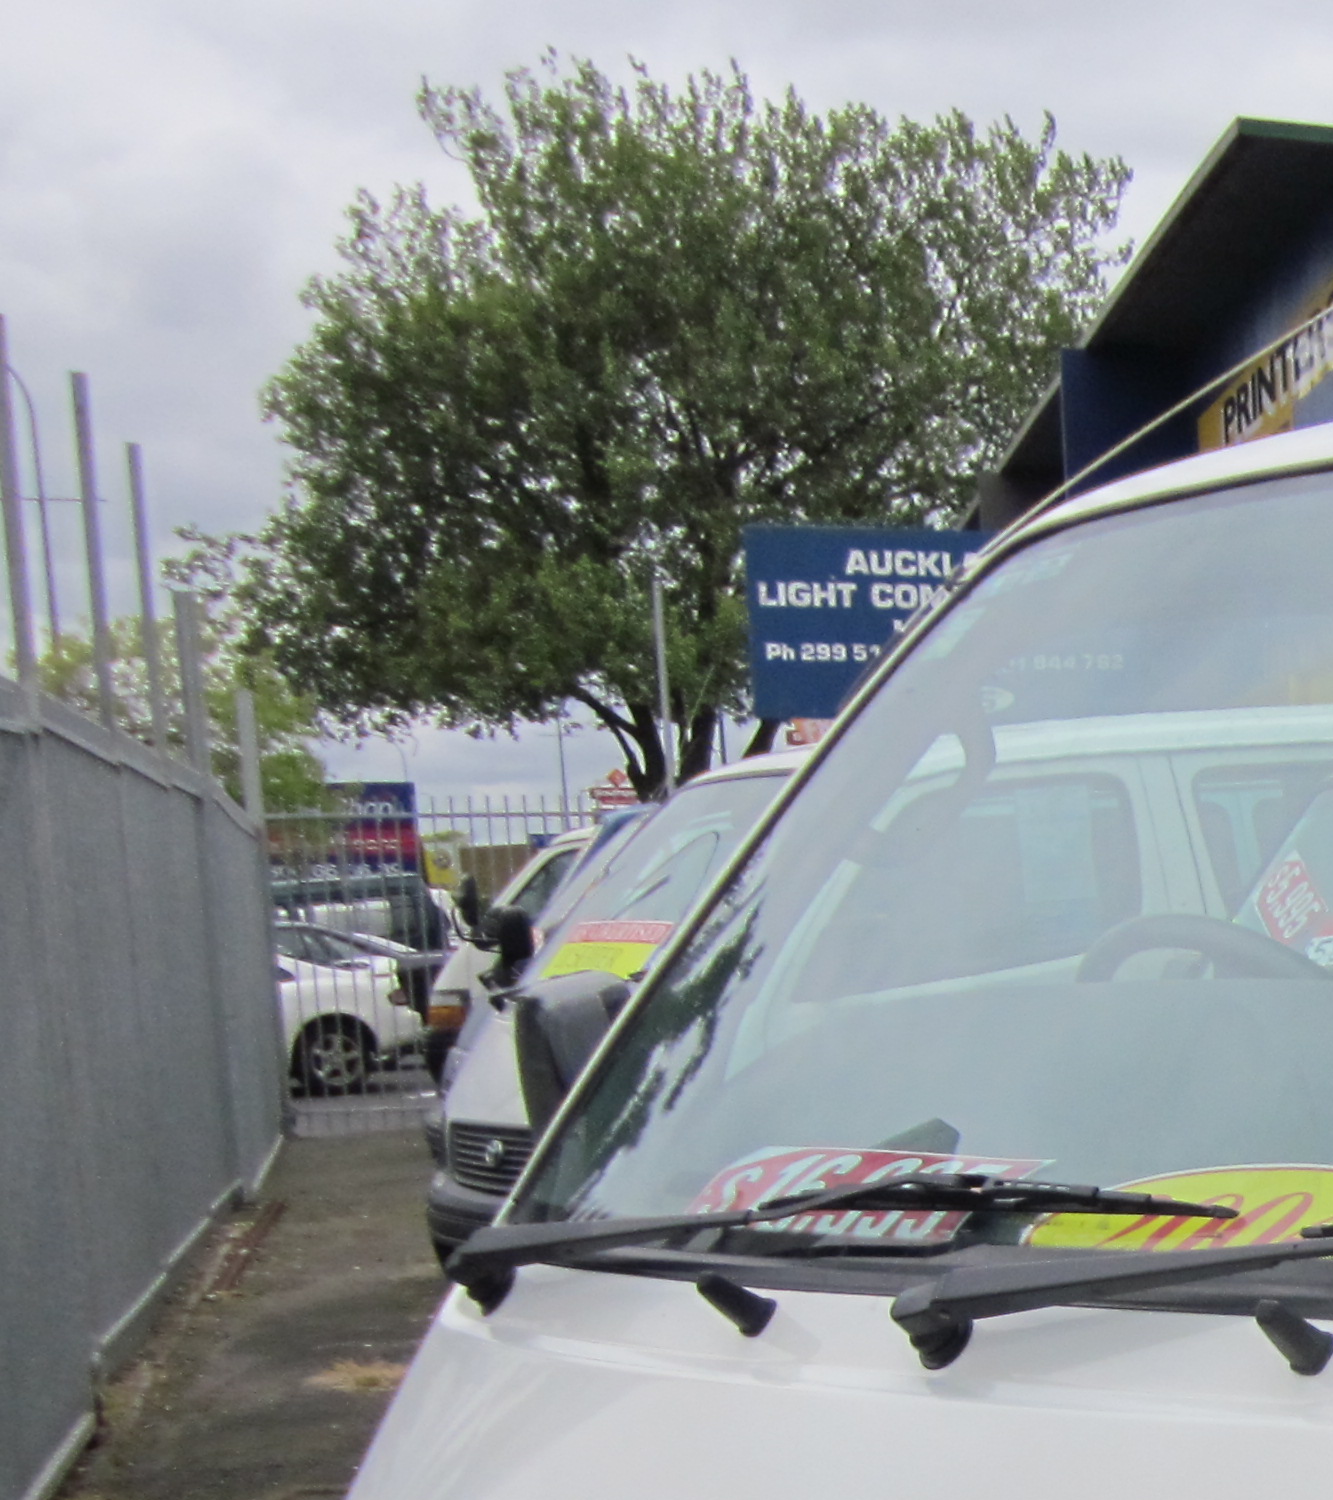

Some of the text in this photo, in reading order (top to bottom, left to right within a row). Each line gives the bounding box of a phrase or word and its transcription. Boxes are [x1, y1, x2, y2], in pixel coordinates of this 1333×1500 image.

[845, 549, 973, 577] AUCKL
[757, 580, 957, 610] LIGHT COM
[764, 641, 796, 661] Ph
[800, 642, 848, 662] 299
